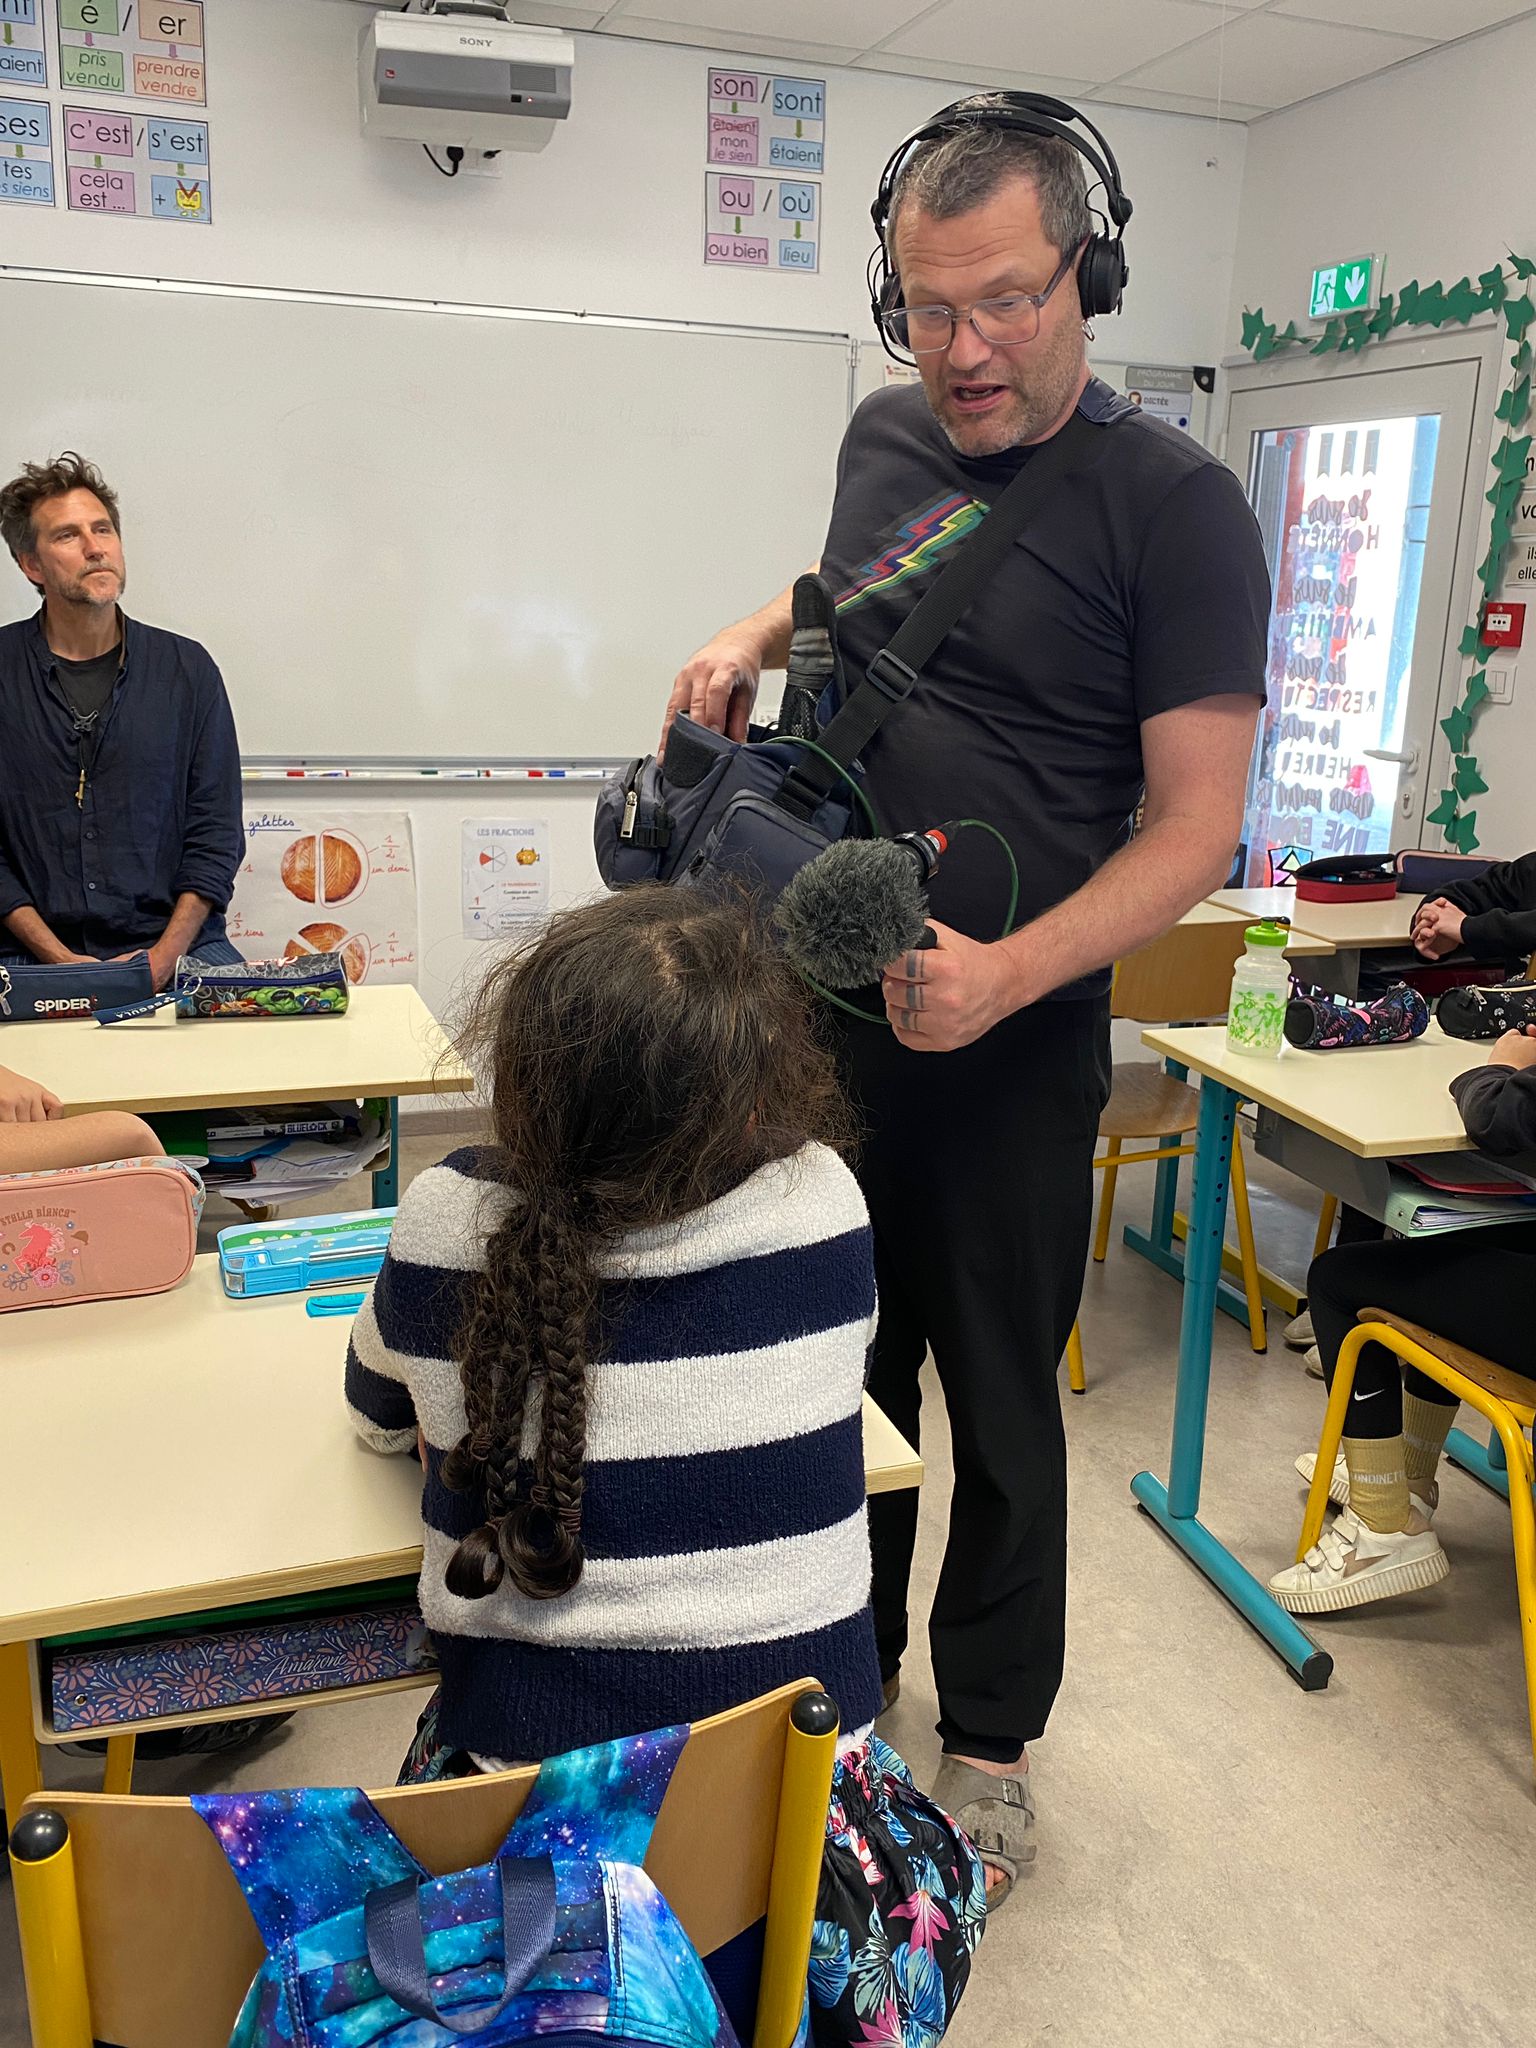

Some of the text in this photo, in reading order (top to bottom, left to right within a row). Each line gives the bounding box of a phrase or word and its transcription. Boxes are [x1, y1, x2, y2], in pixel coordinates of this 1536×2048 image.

[80, 0, 99, 24] é
[158, 16, 187, 36] er
[459, 37, 493, 47] SONY
[78, 50, 106, 67] pris
[66, 70, 120, 88] vendu
[136, 61, 200, 79] prendre
[140, 79, 197, 97] vendre
[712, 77, 755, 98] son
[773, 91, 822, 114] sont
[69, 119, 130, 145] c'est
[151, 128, 204, 153] s'est
[720, 134, 749, 148] mon
[714, 147, 753, 162] le sien
[770, 142, 822, 164] étaient
[3, 160, 33, 180] tes
[12, 181, 49, 198] siens
[79, 172, 123, 190] cela
[79, 191, 107, 208] est
[721, 189, 751, 208] ou
[781, 191, 811, 214] où
[707, 241, 769, 260] ou bien
[782, 244, 811, 264] lieu
[249, 814, 295, 836] galettes
[477, 828, 535, 837] LES FRACTIONS
[474, 896, 480, 906] 1
[473, 911, 481, 920] 6
[388, 951, 415, 968] quart
[34, 998, 91, 1013] SPIDER
[115, 1001, 162, 1019] SEGULA
[263, 1653, 349, 1686] Amazone
